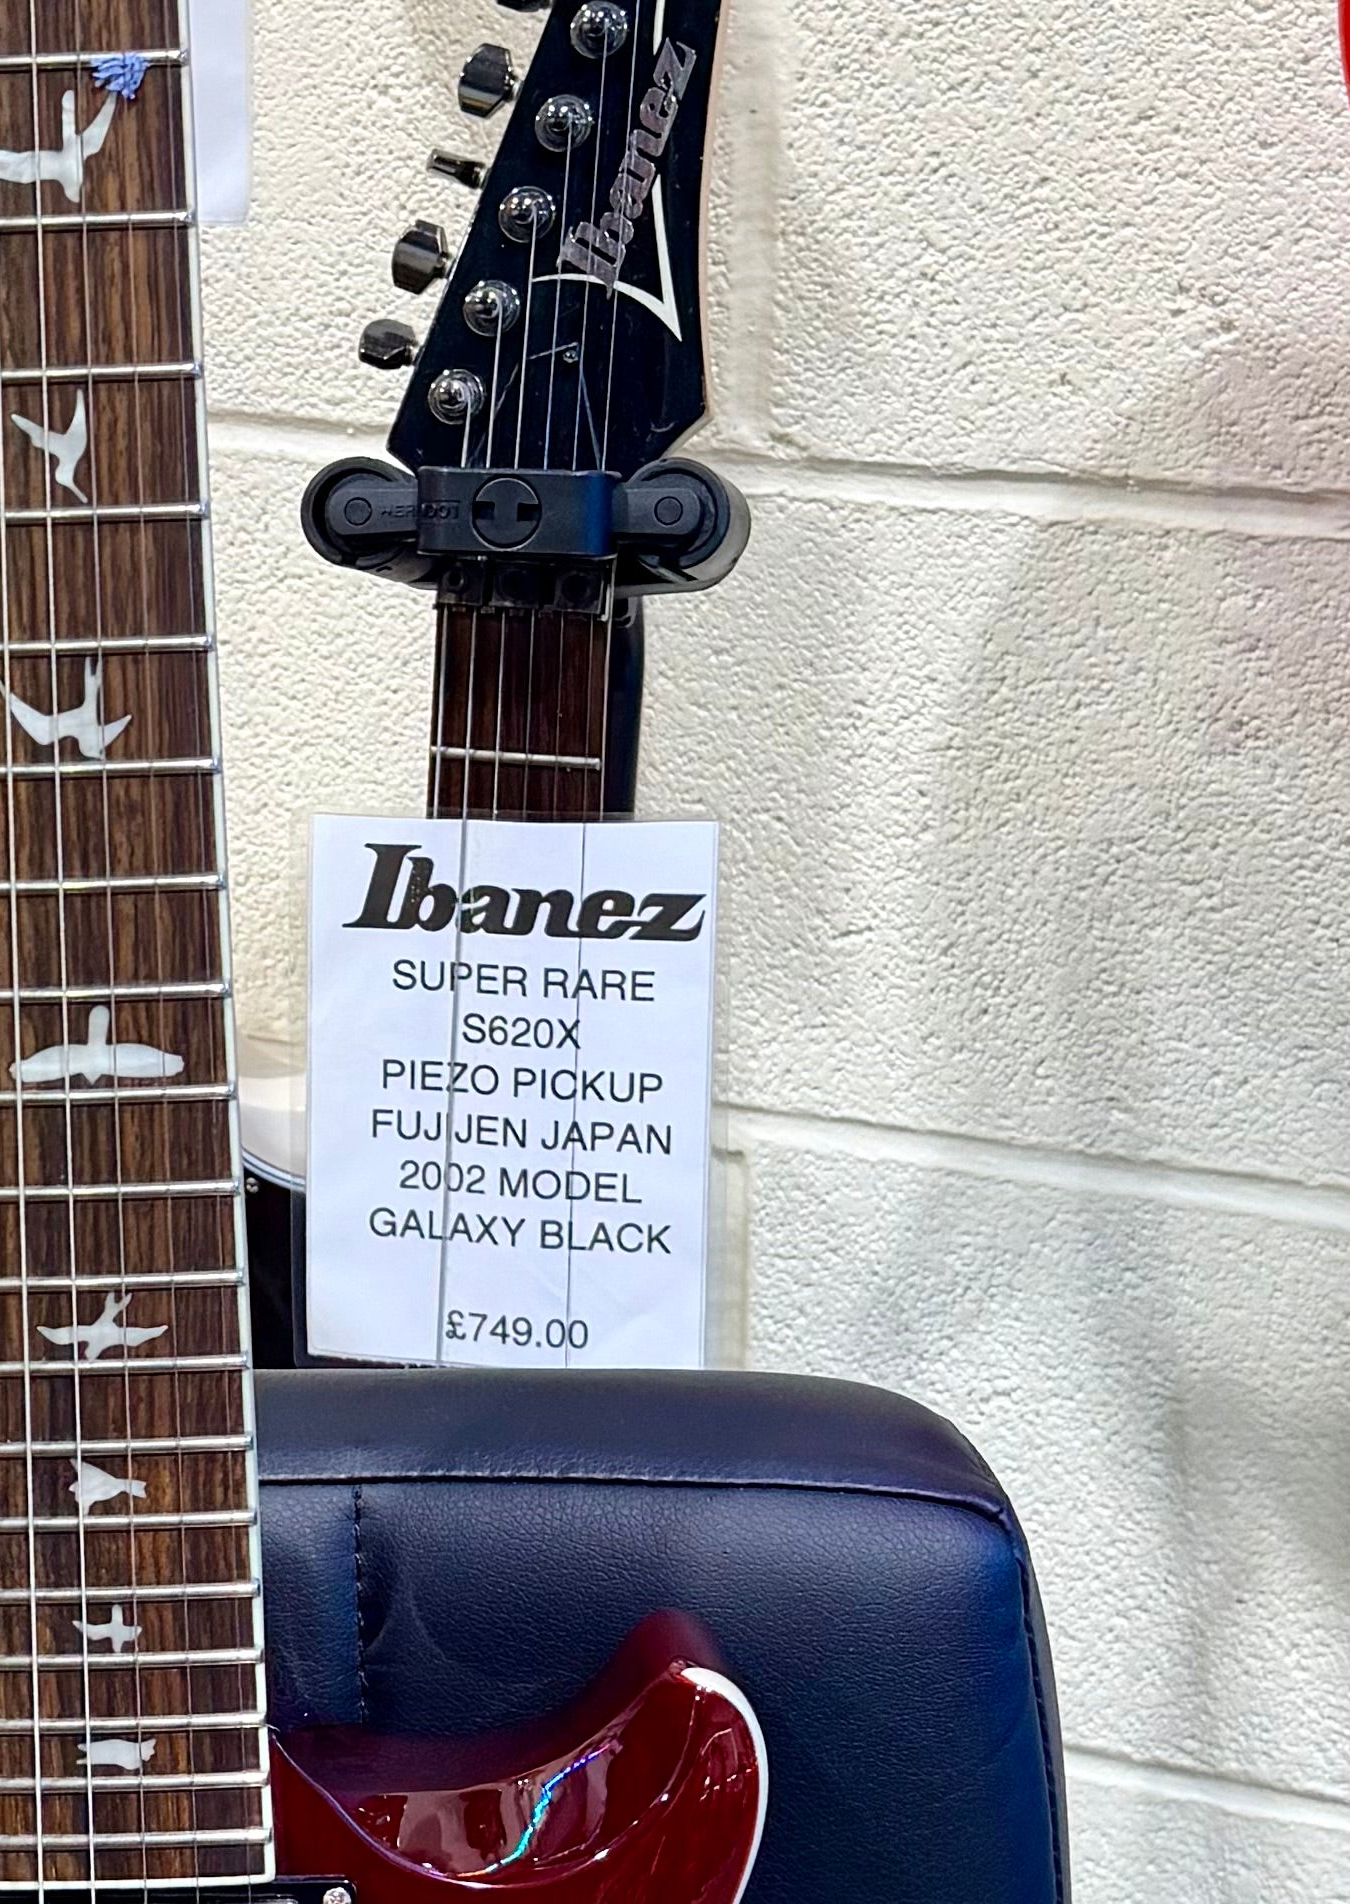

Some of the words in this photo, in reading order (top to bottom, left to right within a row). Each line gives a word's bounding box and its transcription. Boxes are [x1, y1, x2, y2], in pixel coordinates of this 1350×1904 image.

[556, 37, 697, 300] Ibanez
[341, 842, 707, 942] Ibanez
[391, 959, 528, 997] SUPER
[543, 968, 655, 1002] RARE
[461, 1013, 581, 1049] S620X
[381, 1059, 500, 1096] PIEZO
[512, 1067, 664, 1104] PICKUP
[541, 1118, 672, 1156] JAPAN
[398, 1160, 486, 1195] 2002
[498, 1166, 643, 1204] MODEL
[368, 1208, 526, 1248] GALAXY
[539, 1218, 672, 1256] BLACK
[445, 1310, 589, 1351] £749.00
